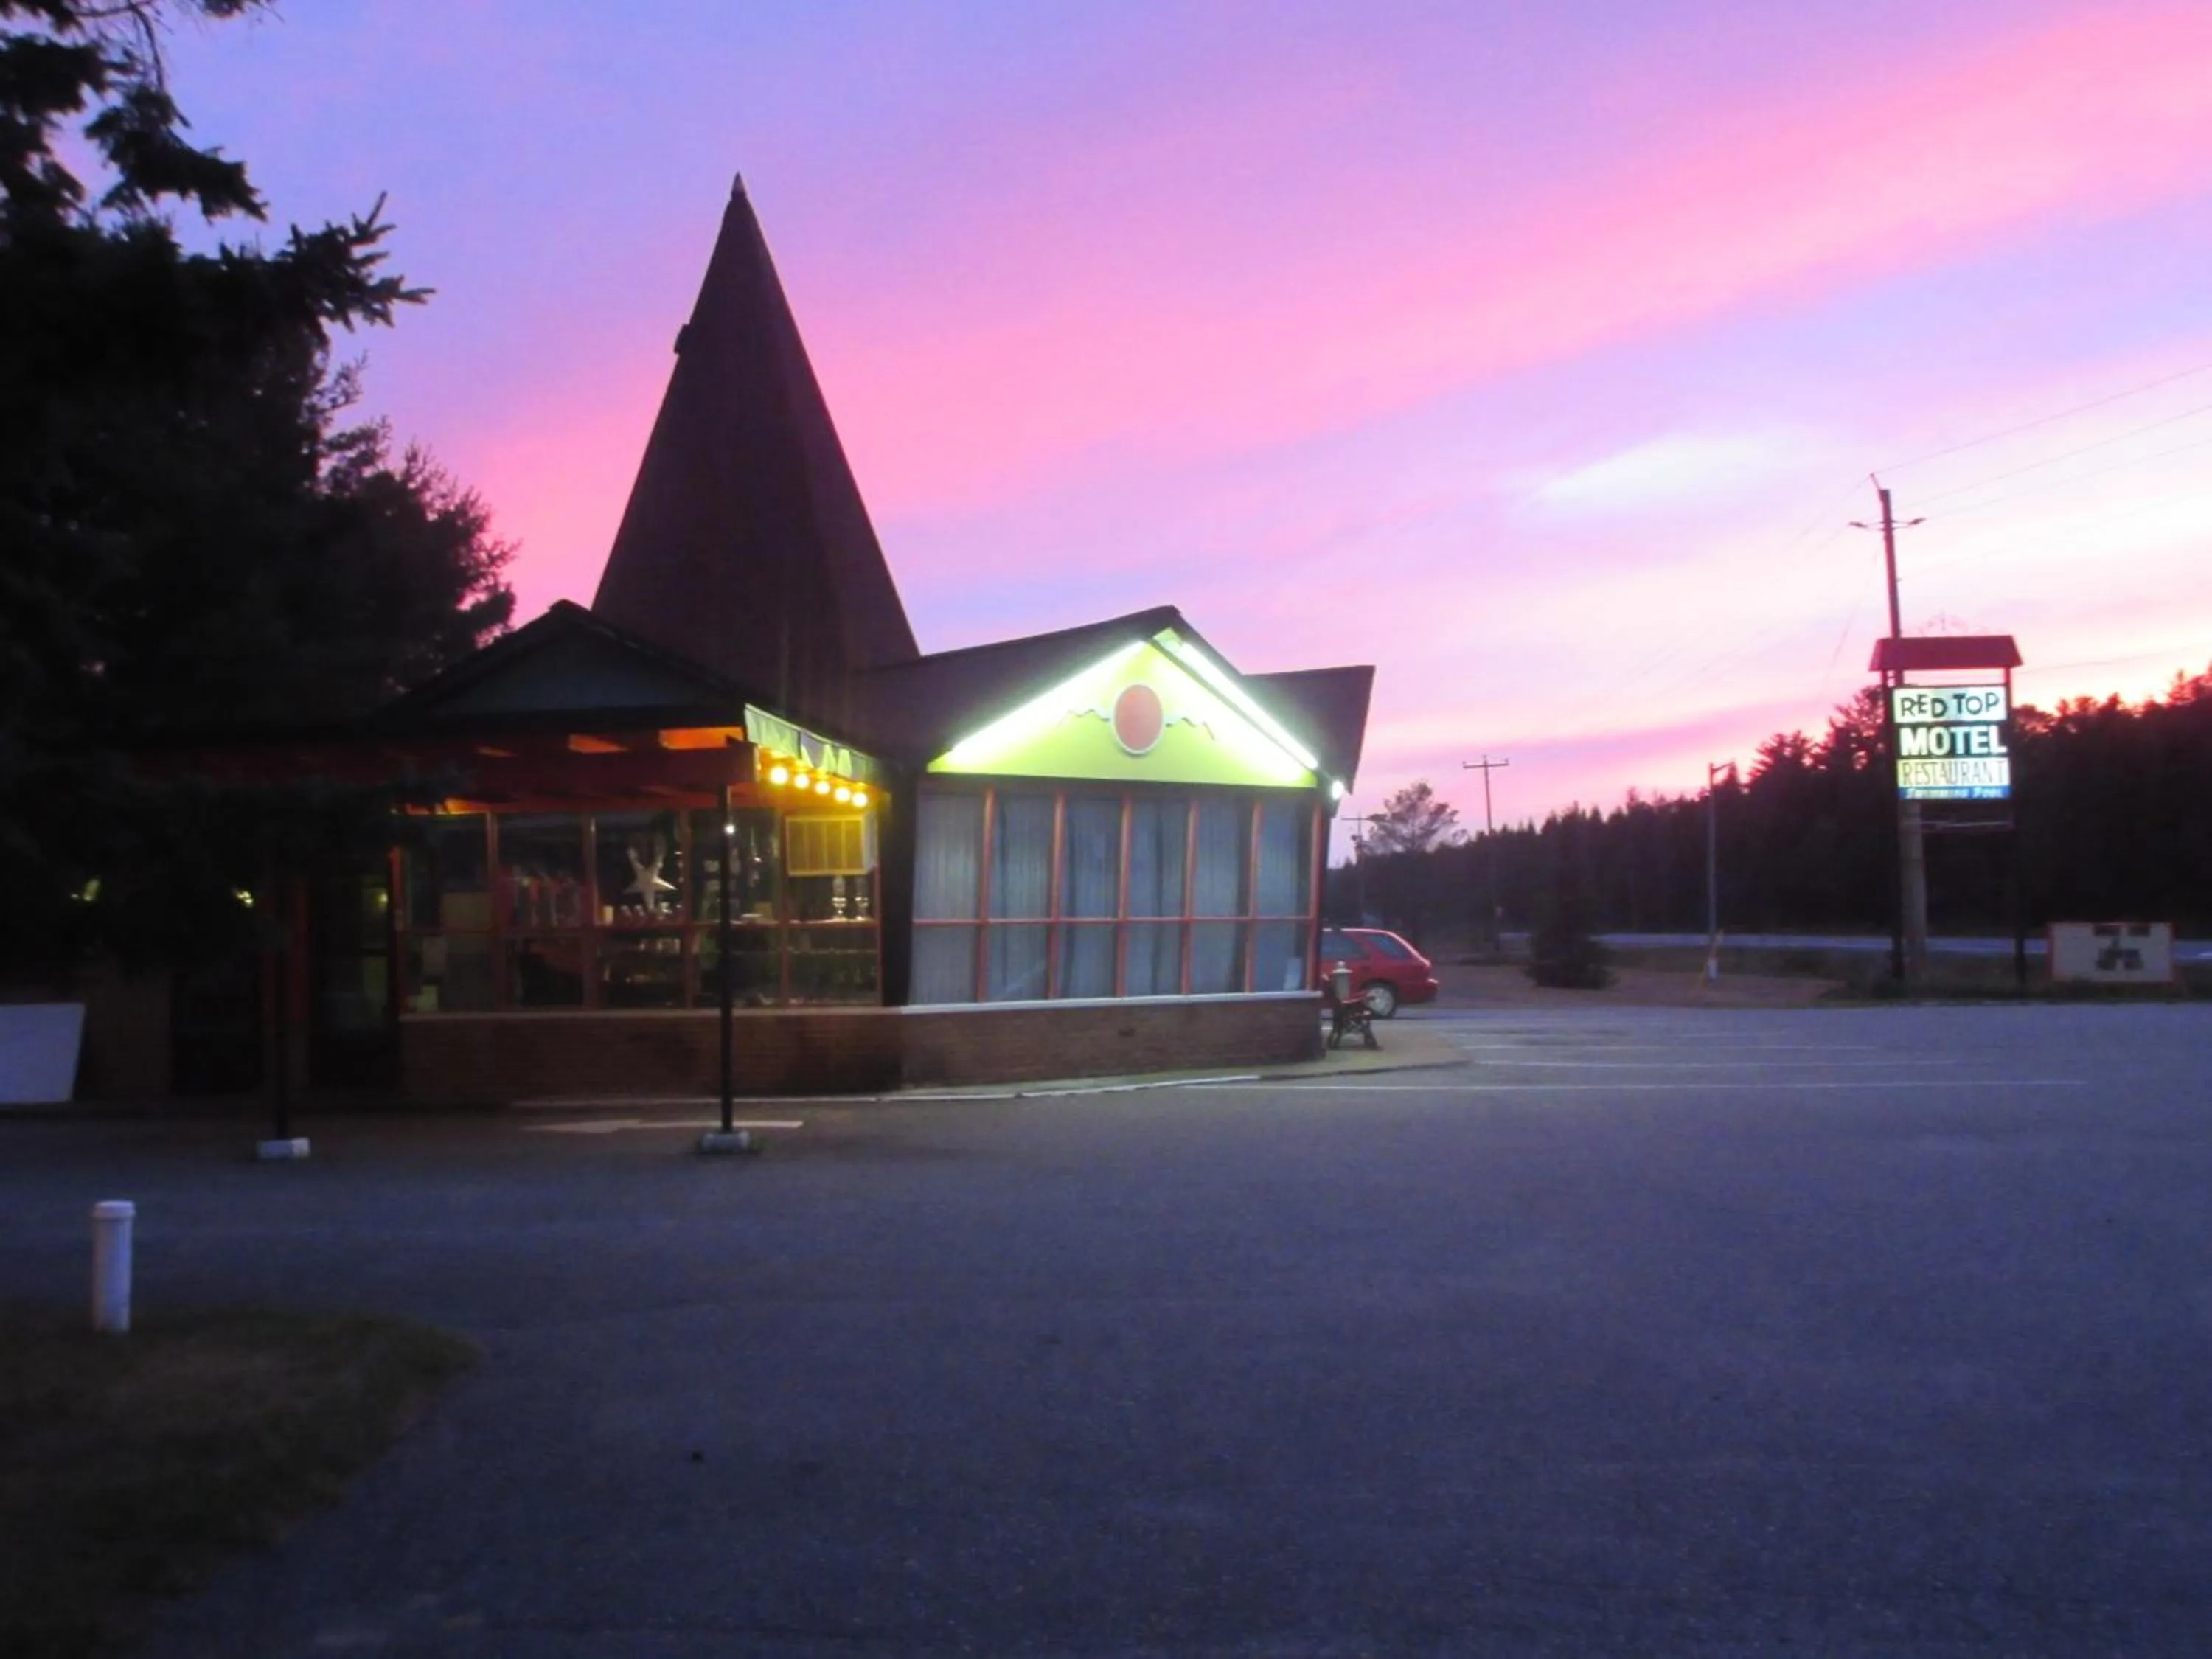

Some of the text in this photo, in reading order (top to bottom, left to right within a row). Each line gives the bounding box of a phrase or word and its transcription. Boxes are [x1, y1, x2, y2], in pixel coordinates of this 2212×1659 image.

[1900, 692, 2000, 718] RED TOP
[1899, 725, 2007, 756] MOTEL
[1902, 760, 2006, 785] RESTAURANT
